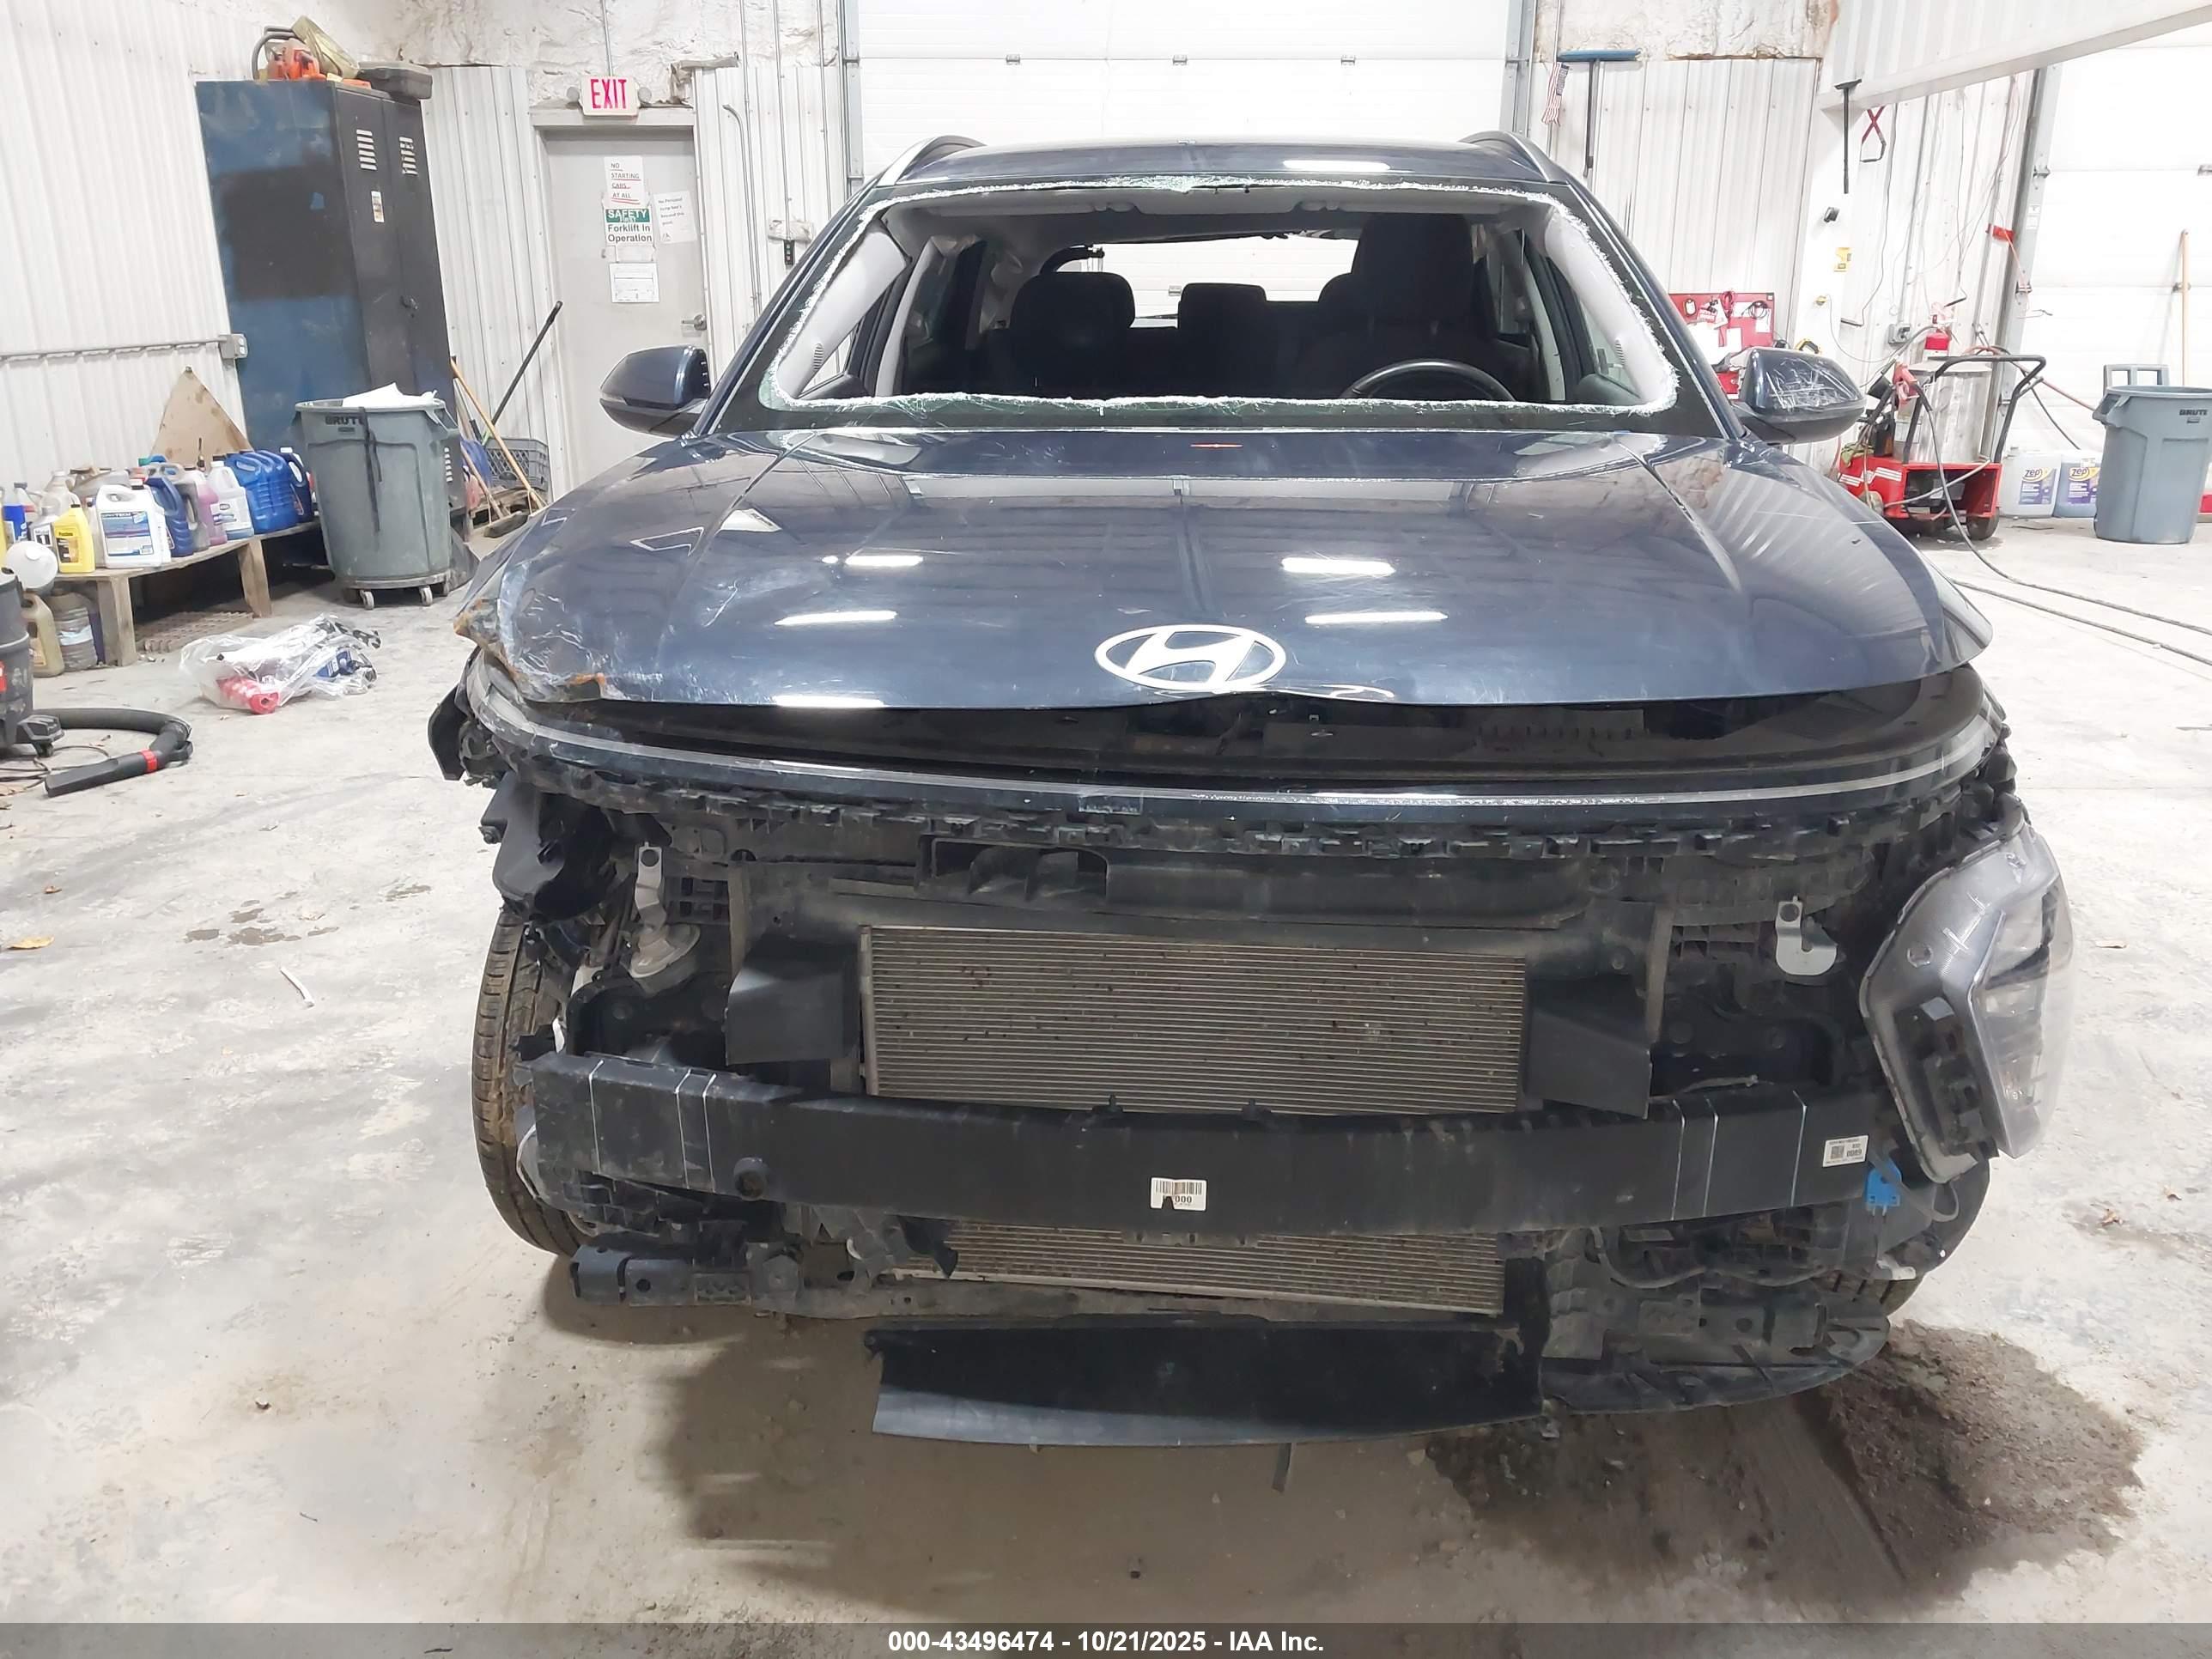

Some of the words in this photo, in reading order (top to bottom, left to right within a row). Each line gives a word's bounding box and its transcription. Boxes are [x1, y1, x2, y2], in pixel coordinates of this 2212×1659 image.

[590, 78, 627, 109] EXIT
[607, 209, 647, 218] SAFETY
[608, 223, 640, 233] Forklift
[642, 223, 651, 232] In
[608, 234, 653, 244] Operation
